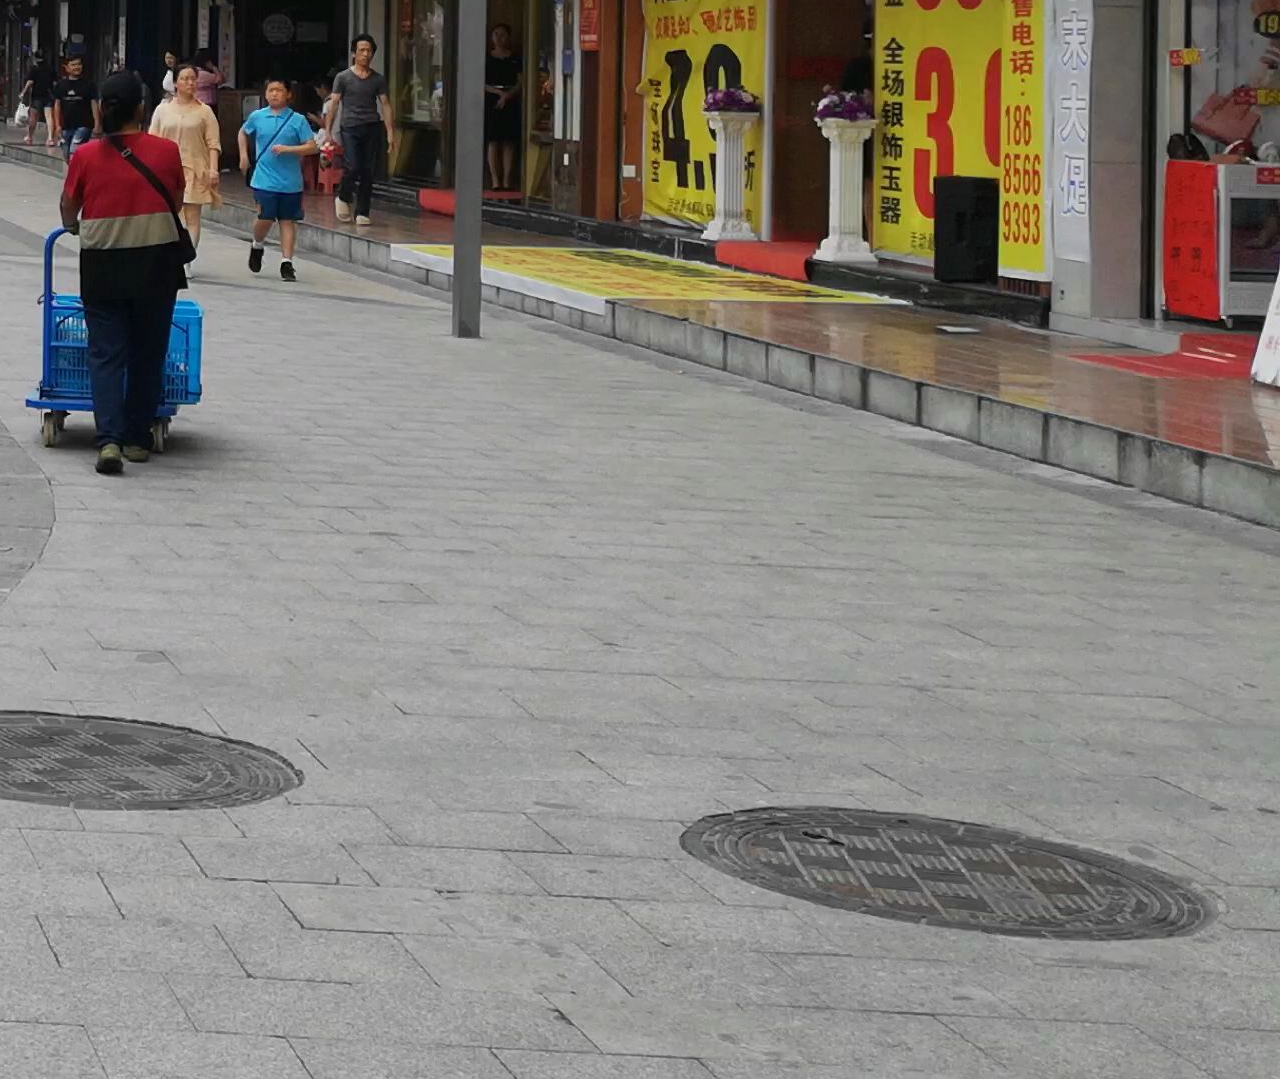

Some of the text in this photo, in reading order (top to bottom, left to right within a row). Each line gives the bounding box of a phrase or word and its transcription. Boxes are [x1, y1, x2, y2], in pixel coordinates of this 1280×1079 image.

[879, 39, 905, 225] 全场银饰玉器
[1004, 105, 1032, 146] 186
[1003, 152, 1041, 196] 8566
[1003, 203, 1041, 246] 9393
